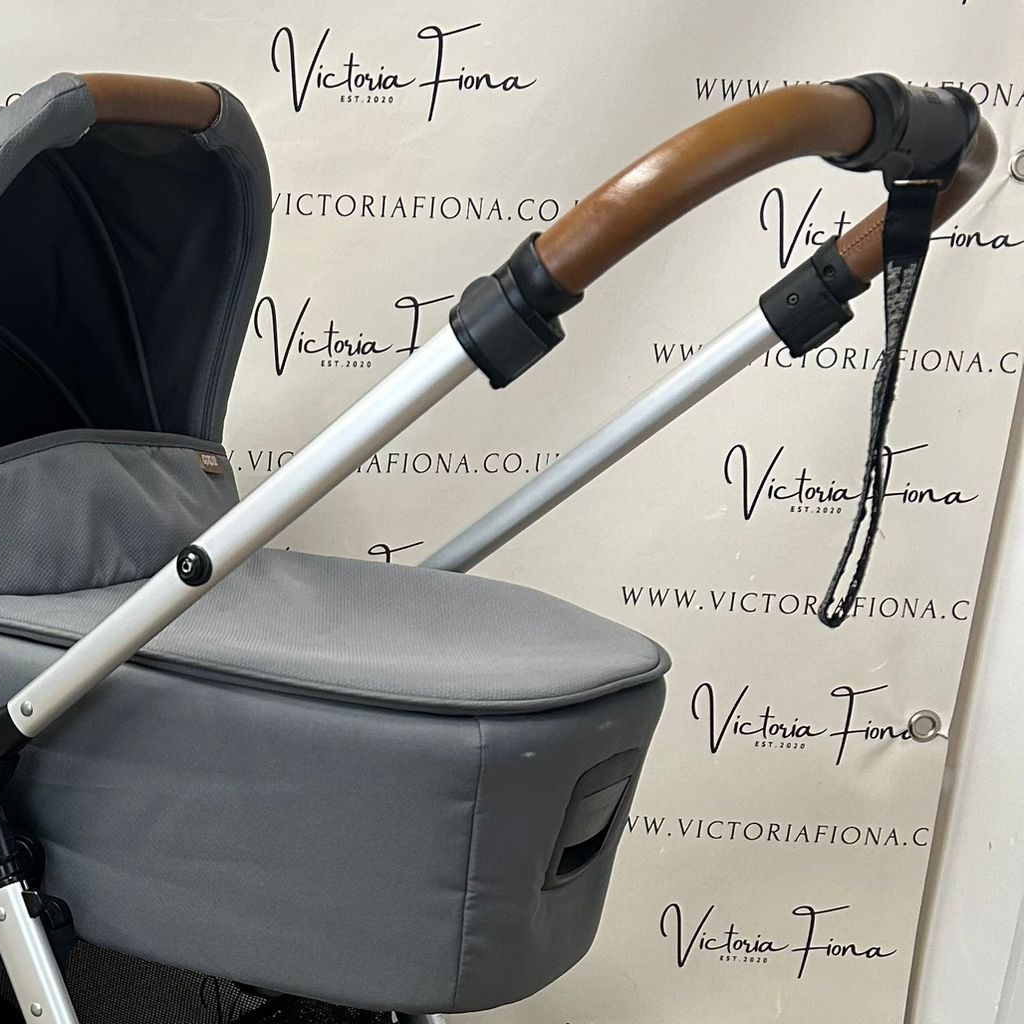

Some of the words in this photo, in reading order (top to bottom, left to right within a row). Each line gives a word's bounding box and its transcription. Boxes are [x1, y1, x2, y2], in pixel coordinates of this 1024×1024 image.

[270, 25, 416, 113] Victoria
[417, 22, 538, 123] Fiona
[253, 295, 394, 377] Victoria
[723, 443, 863, 521] Victoria
[690, 682, 828, 755] Victoria
[659, 903, 790, 968] Victoria
[791, 905, 898, 980] Fiona
